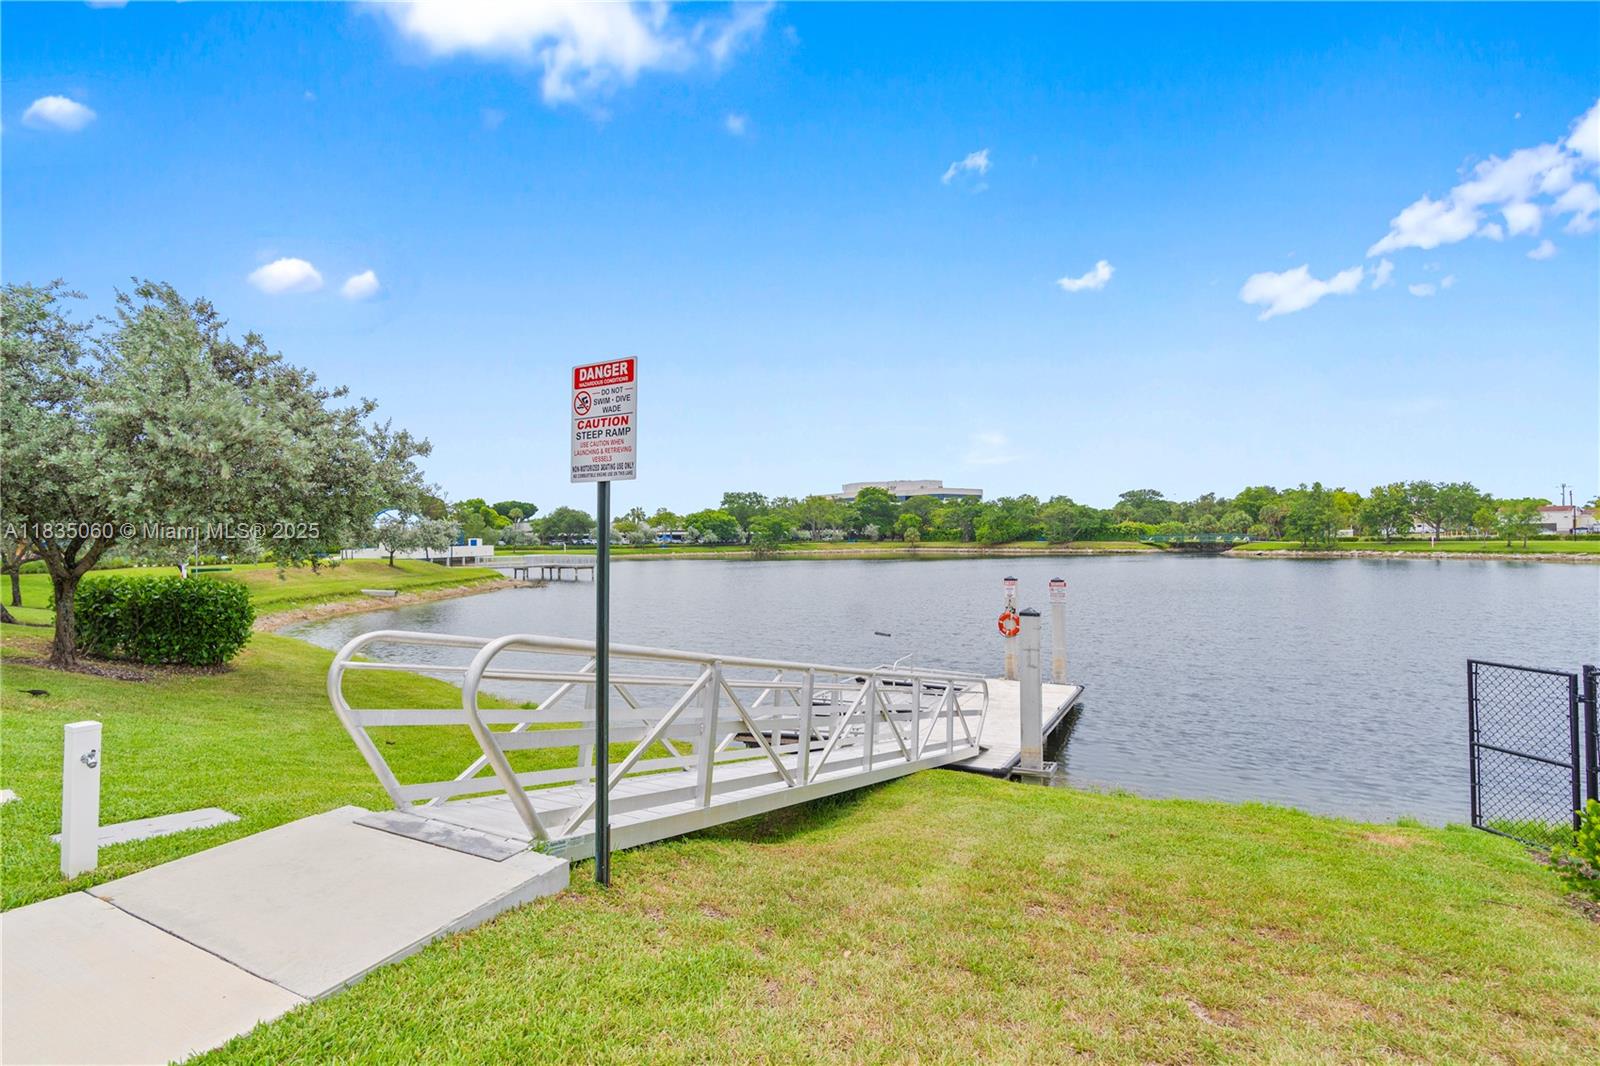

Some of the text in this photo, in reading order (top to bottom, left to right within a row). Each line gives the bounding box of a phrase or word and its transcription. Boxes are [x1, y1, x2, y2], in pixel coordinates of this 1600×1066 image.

[579, 362, 628, 381] DANGER
[601, 386, 623, 396] DO NOT
[593, 394, 631, 406] SWIM DIVE
[602, 404, 621, 413] WADE
[577, 416, 629, 430] CAUTION
[576, 427, 631, 441] STEEP RAMP
[590, 439, 609, 447] CAUTION
[611, 438, 624, 446] WHEN
[574, 447, 600, 456] LAUNCHING
[605, 446, 632, 454] RETRIEVING
[625, 461, 634, 469] ONLY
